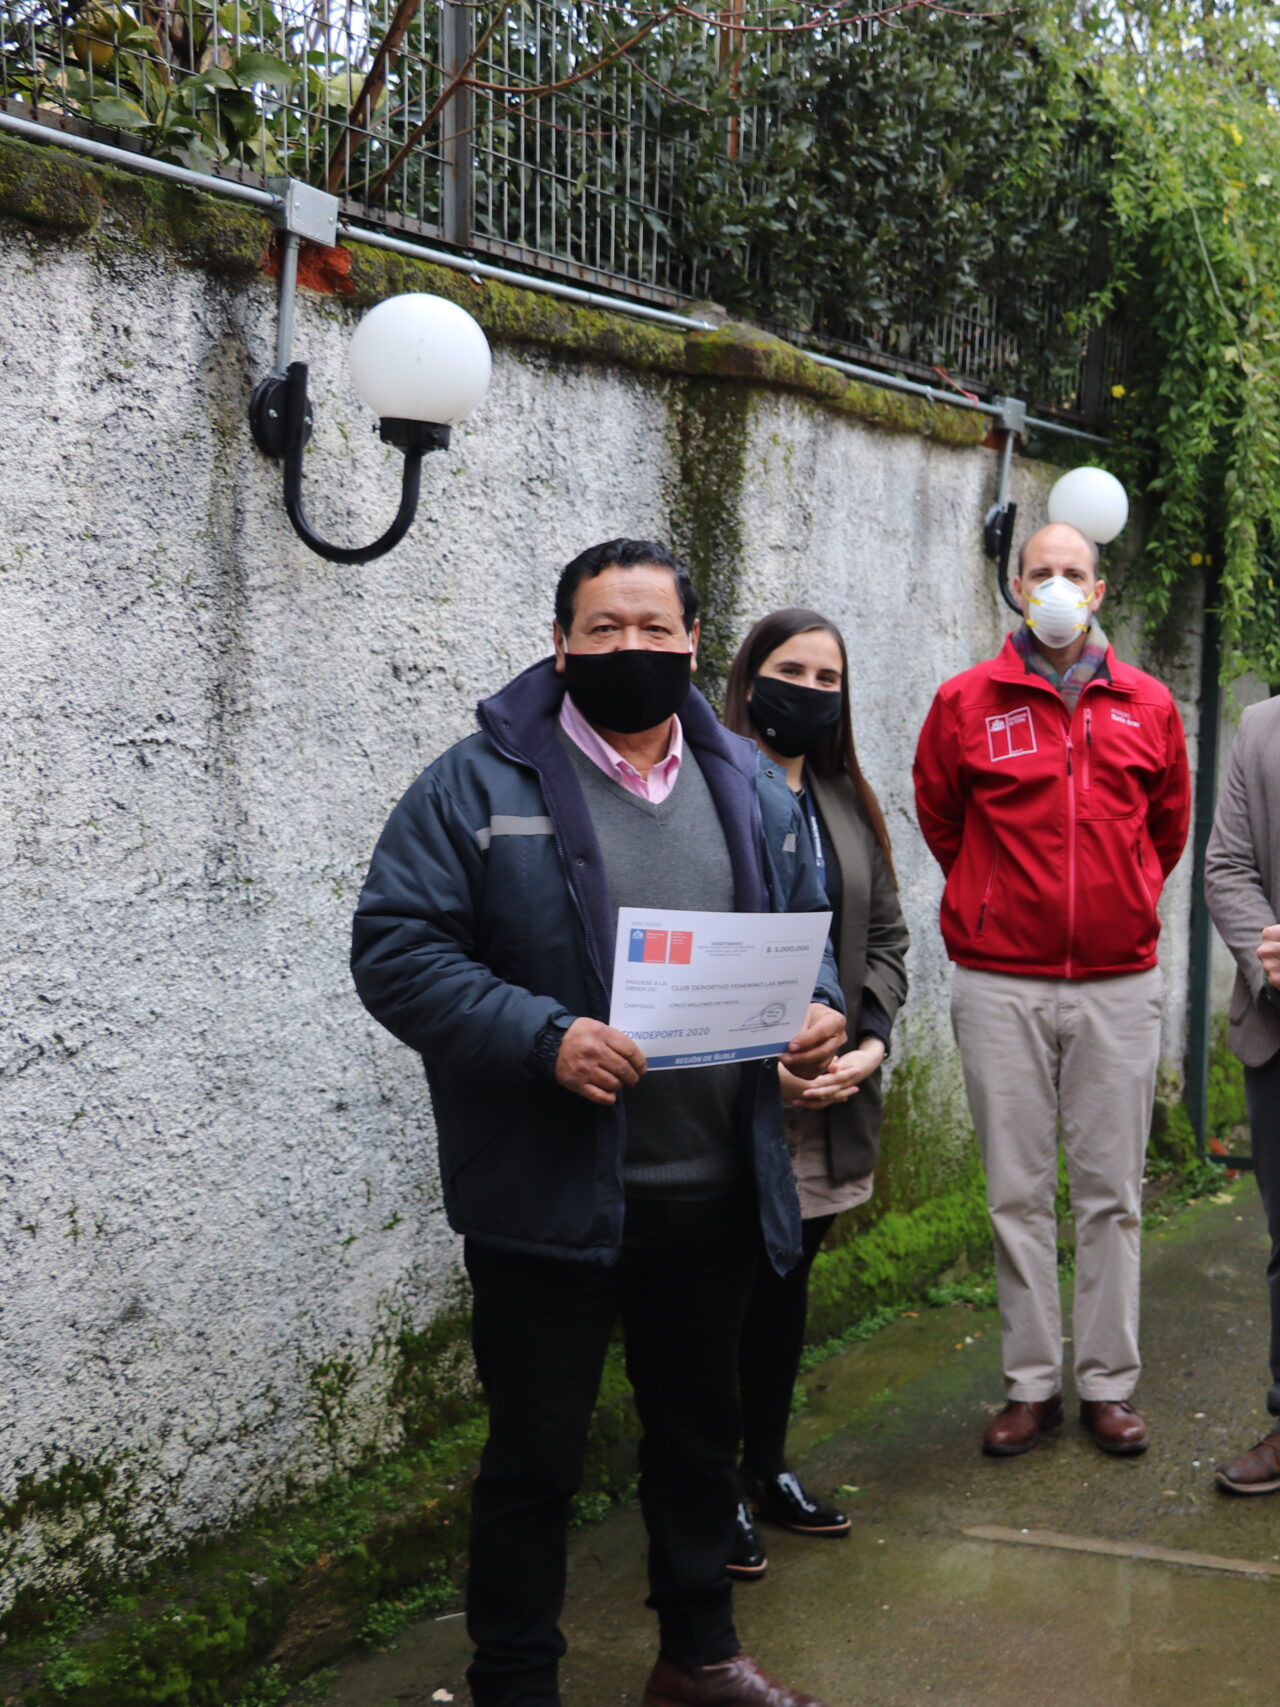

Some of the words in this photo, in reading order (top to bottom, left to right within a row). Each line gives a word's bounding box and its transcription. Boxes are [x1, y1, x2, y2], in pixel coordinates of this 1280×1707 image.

[691, 983, 729, 992] DEPORTIVO
[686, 1027, 710, 1037] 2020
[675, 1055, 702, 1065] REGIÓN
[703, 1053, 713, 1063] DE
